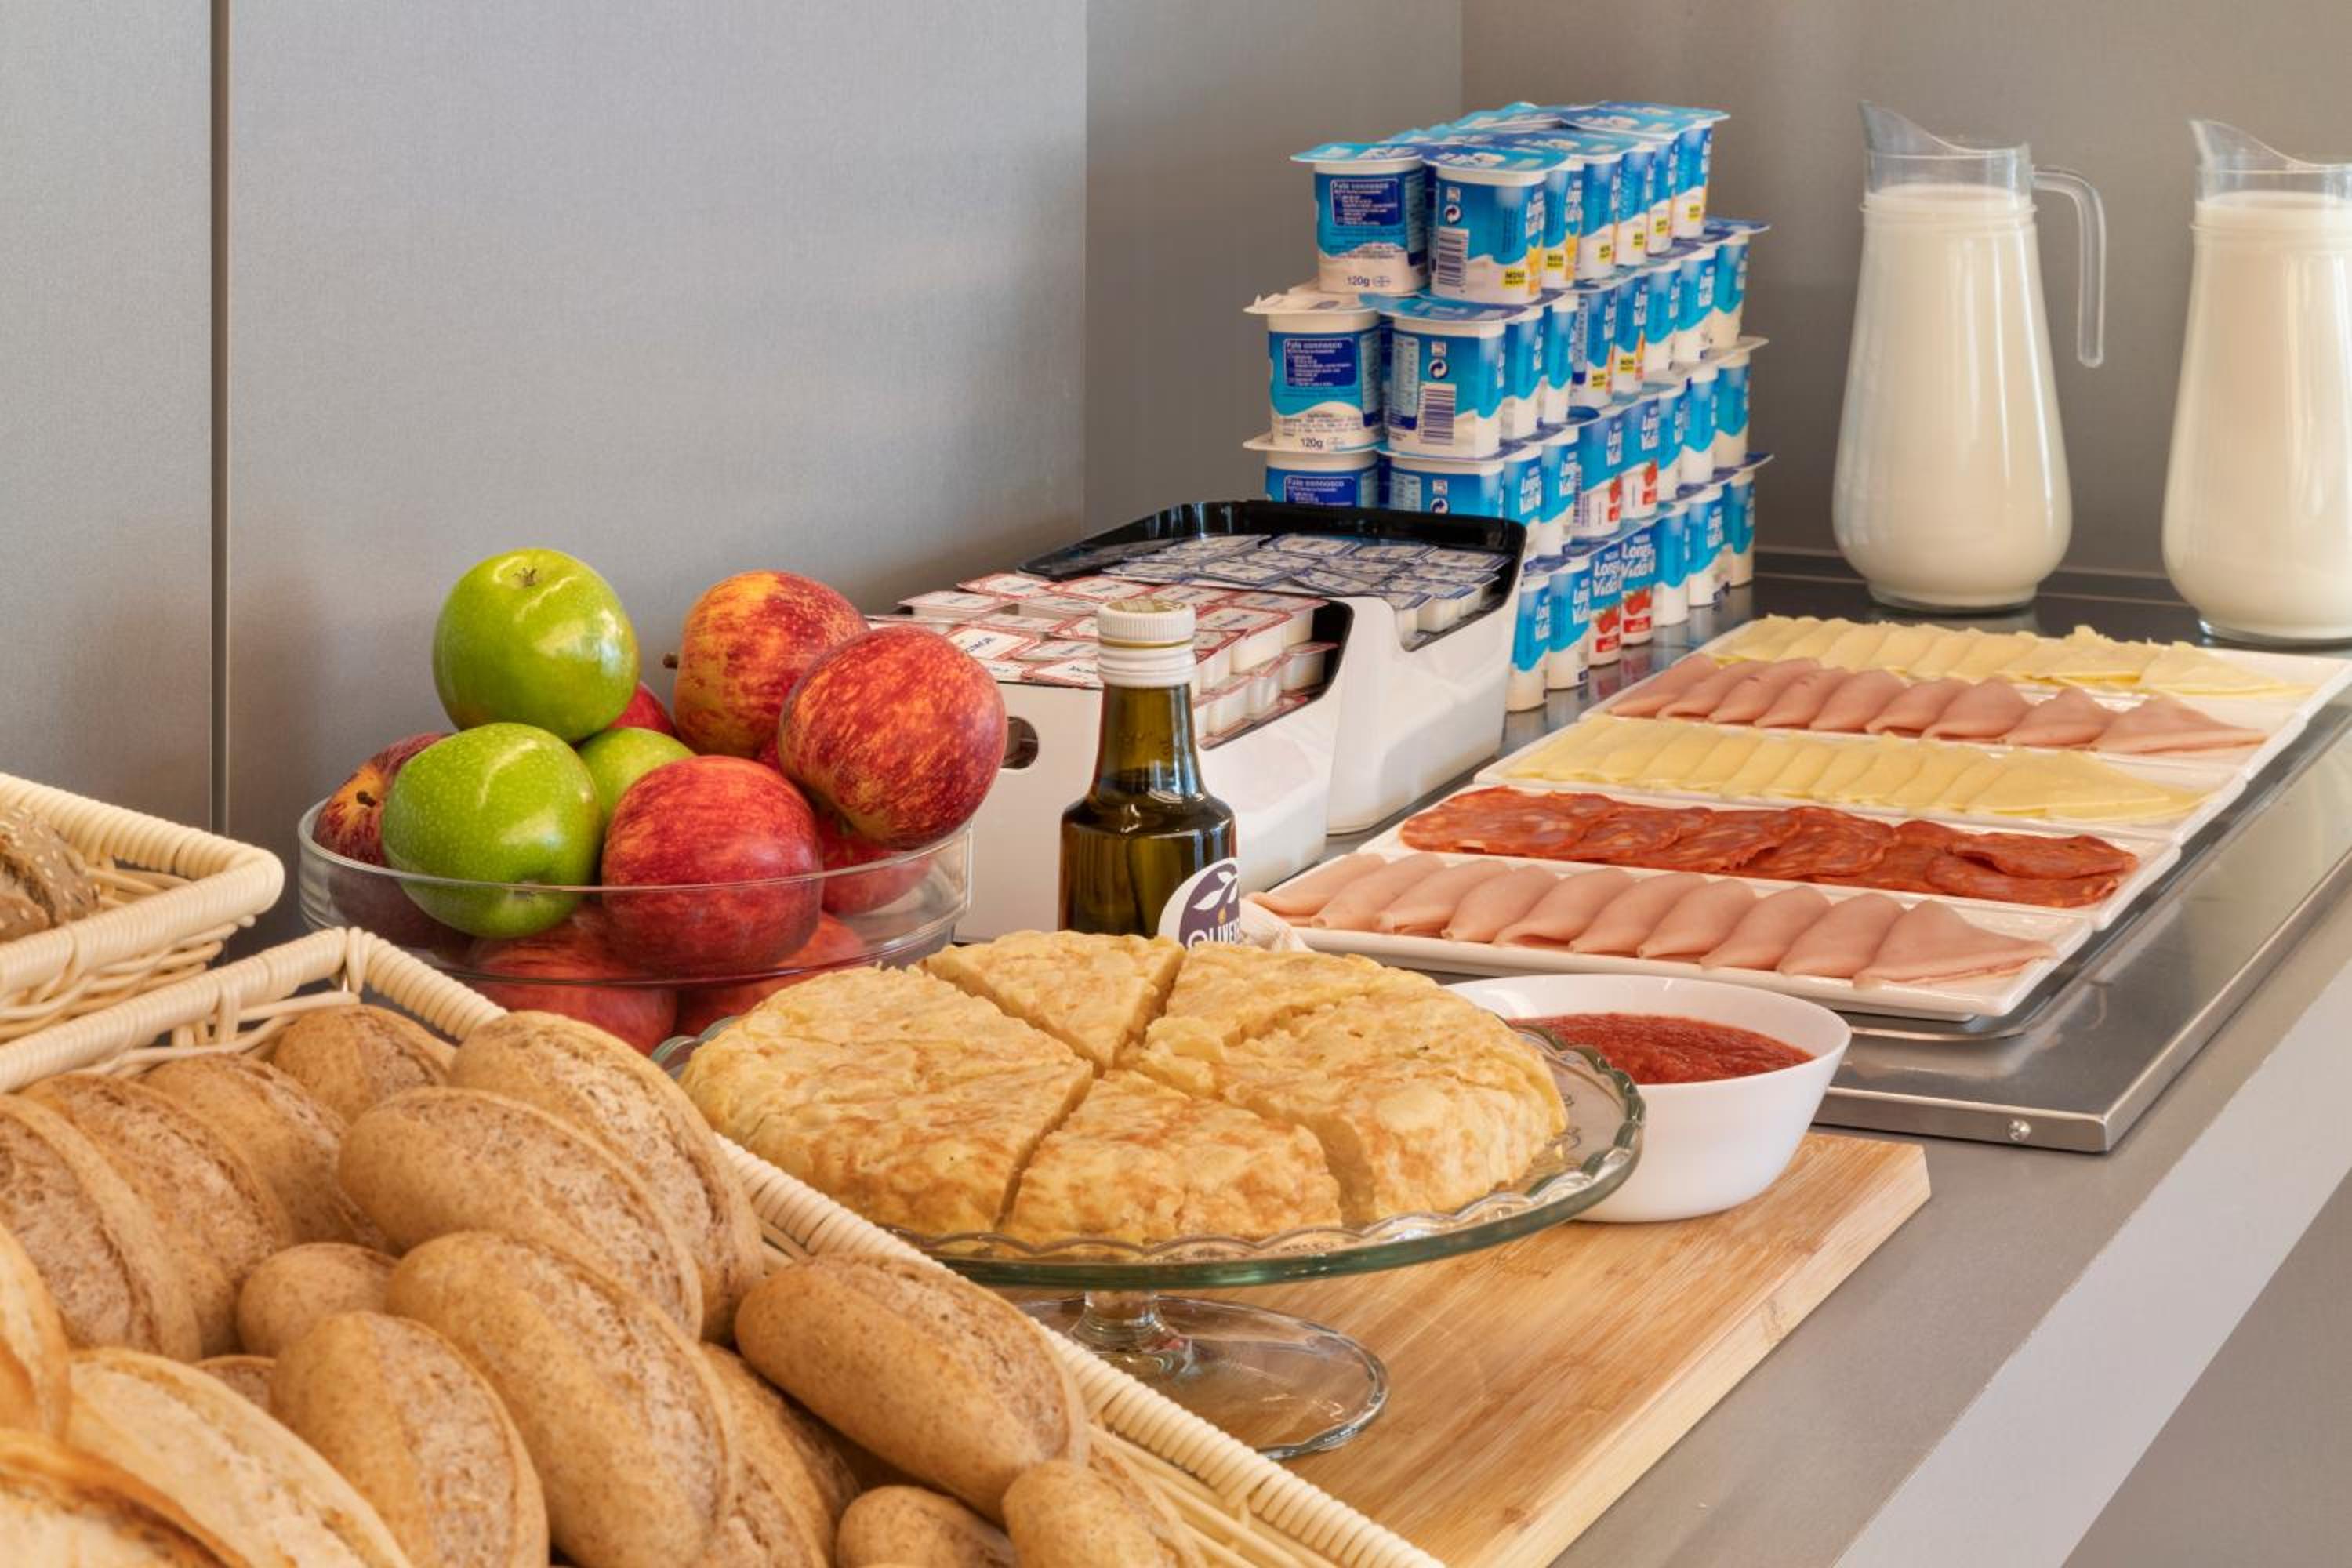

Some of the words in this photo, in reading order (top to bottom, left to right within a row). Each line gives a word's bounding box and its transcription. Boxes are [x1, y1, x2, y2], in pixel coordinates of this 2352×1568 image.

[1347, 276, 1370, 288] 120g
[1301, 438, 1323, 449] 120g
[1621, 560, 1656, 578] Vida
